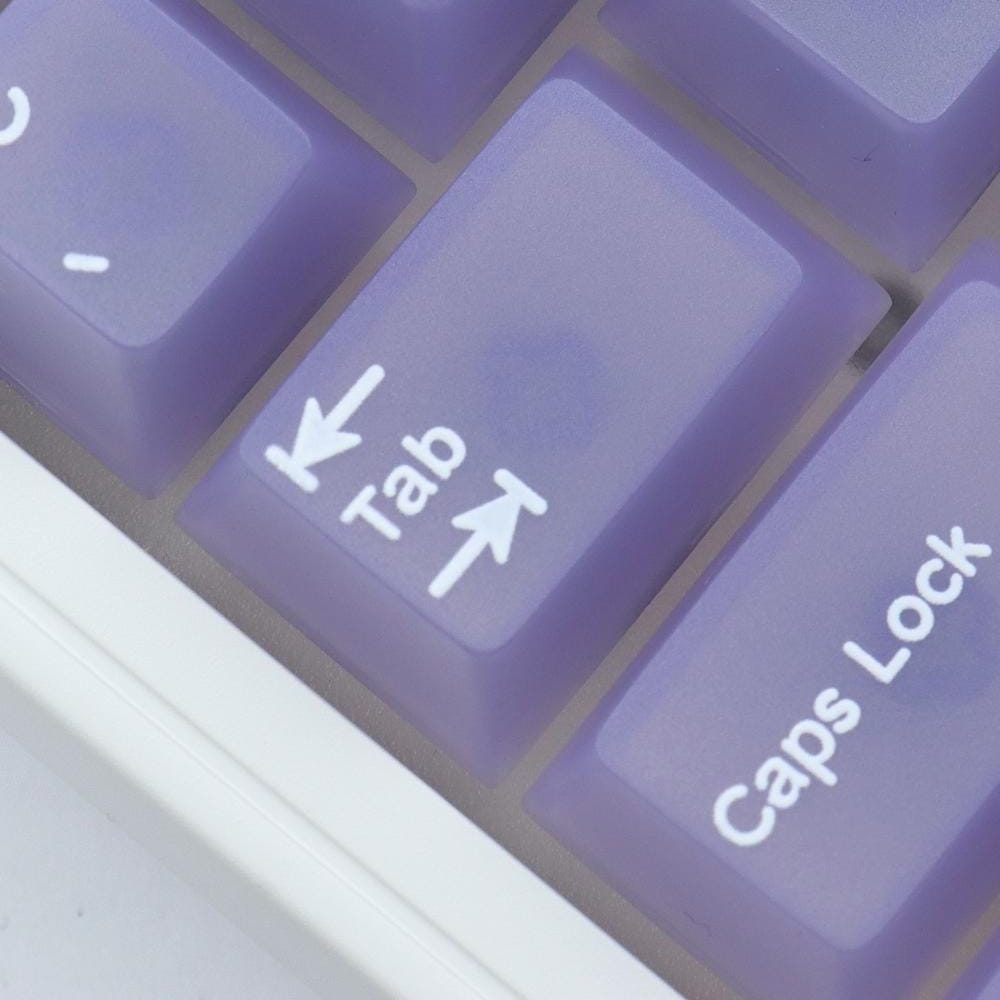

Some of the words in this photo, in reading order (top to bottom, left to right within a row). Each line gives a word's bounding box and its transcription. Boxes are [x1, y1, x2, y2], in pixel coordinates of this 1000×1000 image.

[339, 425, 467, 541] Tab
[712, 686, 862, 847] Caps
[842, 525, 993, 684] Lock
